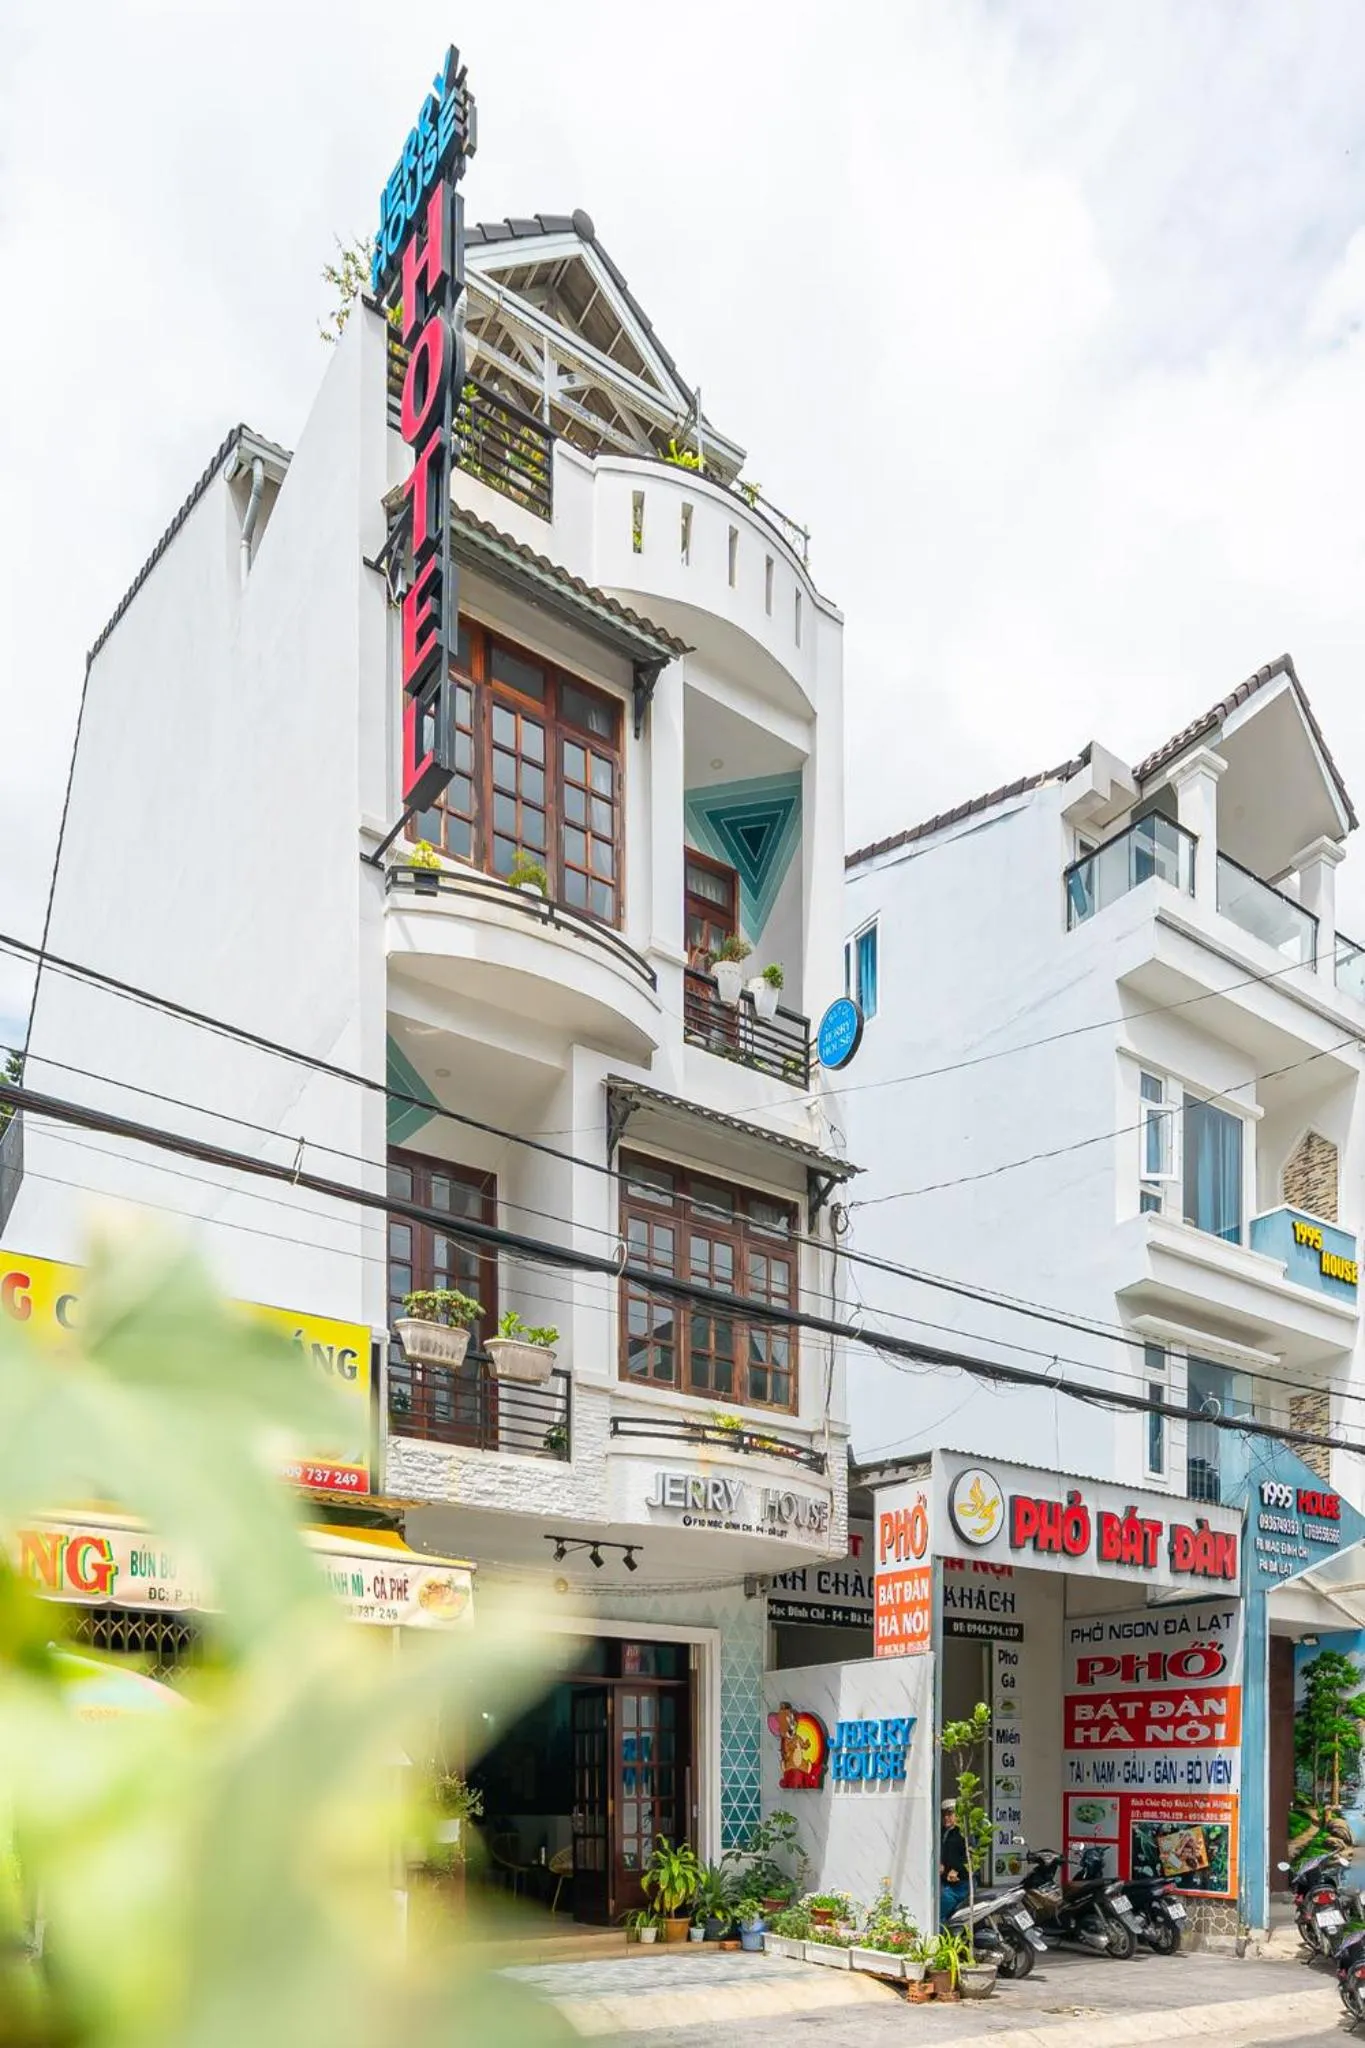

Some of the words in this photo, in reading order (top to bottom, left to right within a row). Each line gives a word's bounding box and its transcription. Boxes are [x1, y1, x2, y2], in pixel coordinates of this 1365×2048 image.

[374, 43, 459, 245] JERRY
[371, 86, 462, 291] HOUSE
[402, 178, 450, 803] HOTEL
[1293, 1221, 1324, 1250] 1995
[1320, 1250, 1358, 1286] HOUSE
[307, 1468, 331, 1483] 737
[334, 1471, 359, 1486] 249
[645, 1471, 744, 1513] JERRY
[760, 1487, 829, 1533] HOUSE
[1260, 1481, 1293, 1508] 1995
[1297, 1488, 1341, 1520] HOUSE
[880, 1491, 928, 1565] PHỞ
[1097, 1505, 1163, 1567] BÁT
[1169, 1518, 1237, 1581] ĐÀN
[130, 1543, 157, 1580] BÚN
[373, 1569, 387, 1600] CÀ
[390, 1572, 410, 1602] PHÊ
[148, 1587, 169, 1601] ĐC:
[879, 1577, 902, 1606] BÁT
[944, 1584, 1015, 1613] KHÁCH
[879, 1608, 899, 1638] HÀ
[1109, 1620, 1159, 1641] NGON
[1164, 1614, 1191, 1635] ĐÀ
[1197, 1613, 1234, 1635] LẠT
[1075, 1699, 1144, 1721] BÁT
[1150, 1695, 1227, 1718] ĐÀN
[827, 1716, 917, 1749] JERRY
[1074, 1721, 1136, 1743] HÀ
[1145, 1719, 1227, 1744] NỘI
[832, 1750, 907, 1780] HOUSE
[1093, 1760, 1116, 1789] NẠM
[1205, 1753, 1232, 1785] VIÊN
